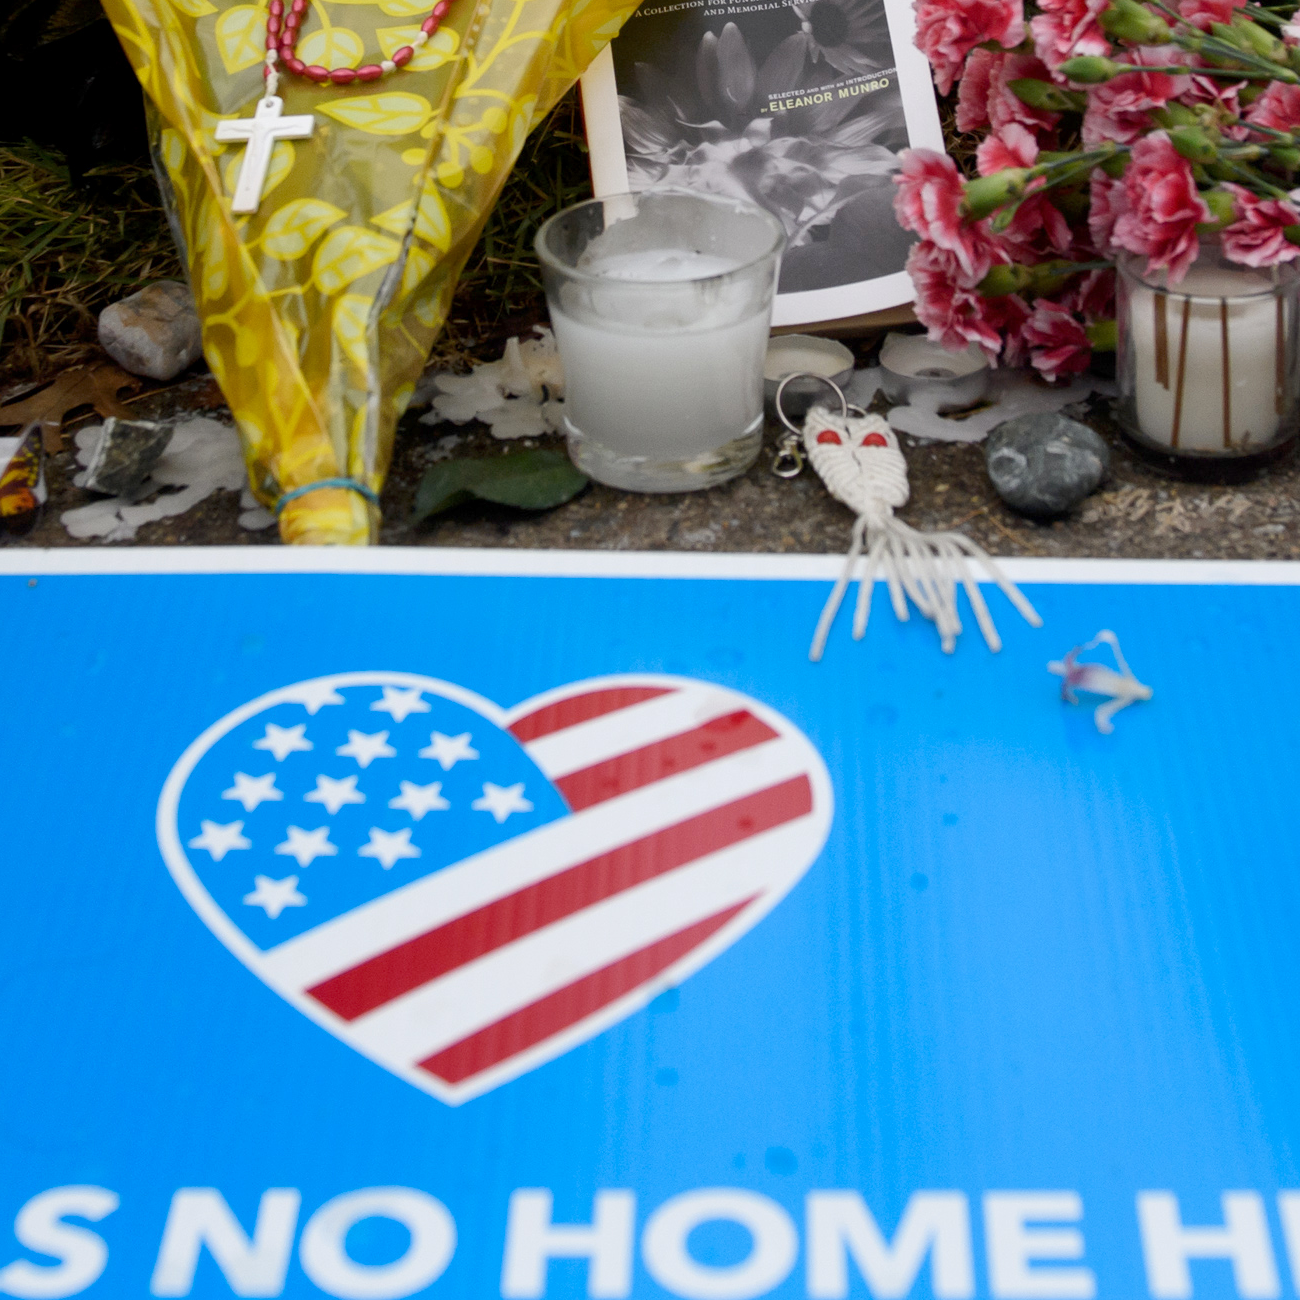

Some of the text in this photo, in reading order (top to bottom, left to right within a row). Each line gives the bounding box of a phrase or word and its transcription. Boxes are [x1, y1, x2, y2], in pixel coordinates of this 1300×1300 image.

[635, 9, 643, 18] A
[643, 0, 705, 17] COLLECTION
[703, 8, 725, 17] AND
[727, 2, 781, 15] MEMORIAL
[768, 89, 806, 100] SELECTED
[846, 67, 898, 86] INTRODUCTION
[769, 92, 833, 112] ELEANOR
[838, 78, 890, 99] MUNRO
[147, 1185, 458, 1300] NO
[500, 1185, 1098, 1300] HOME
